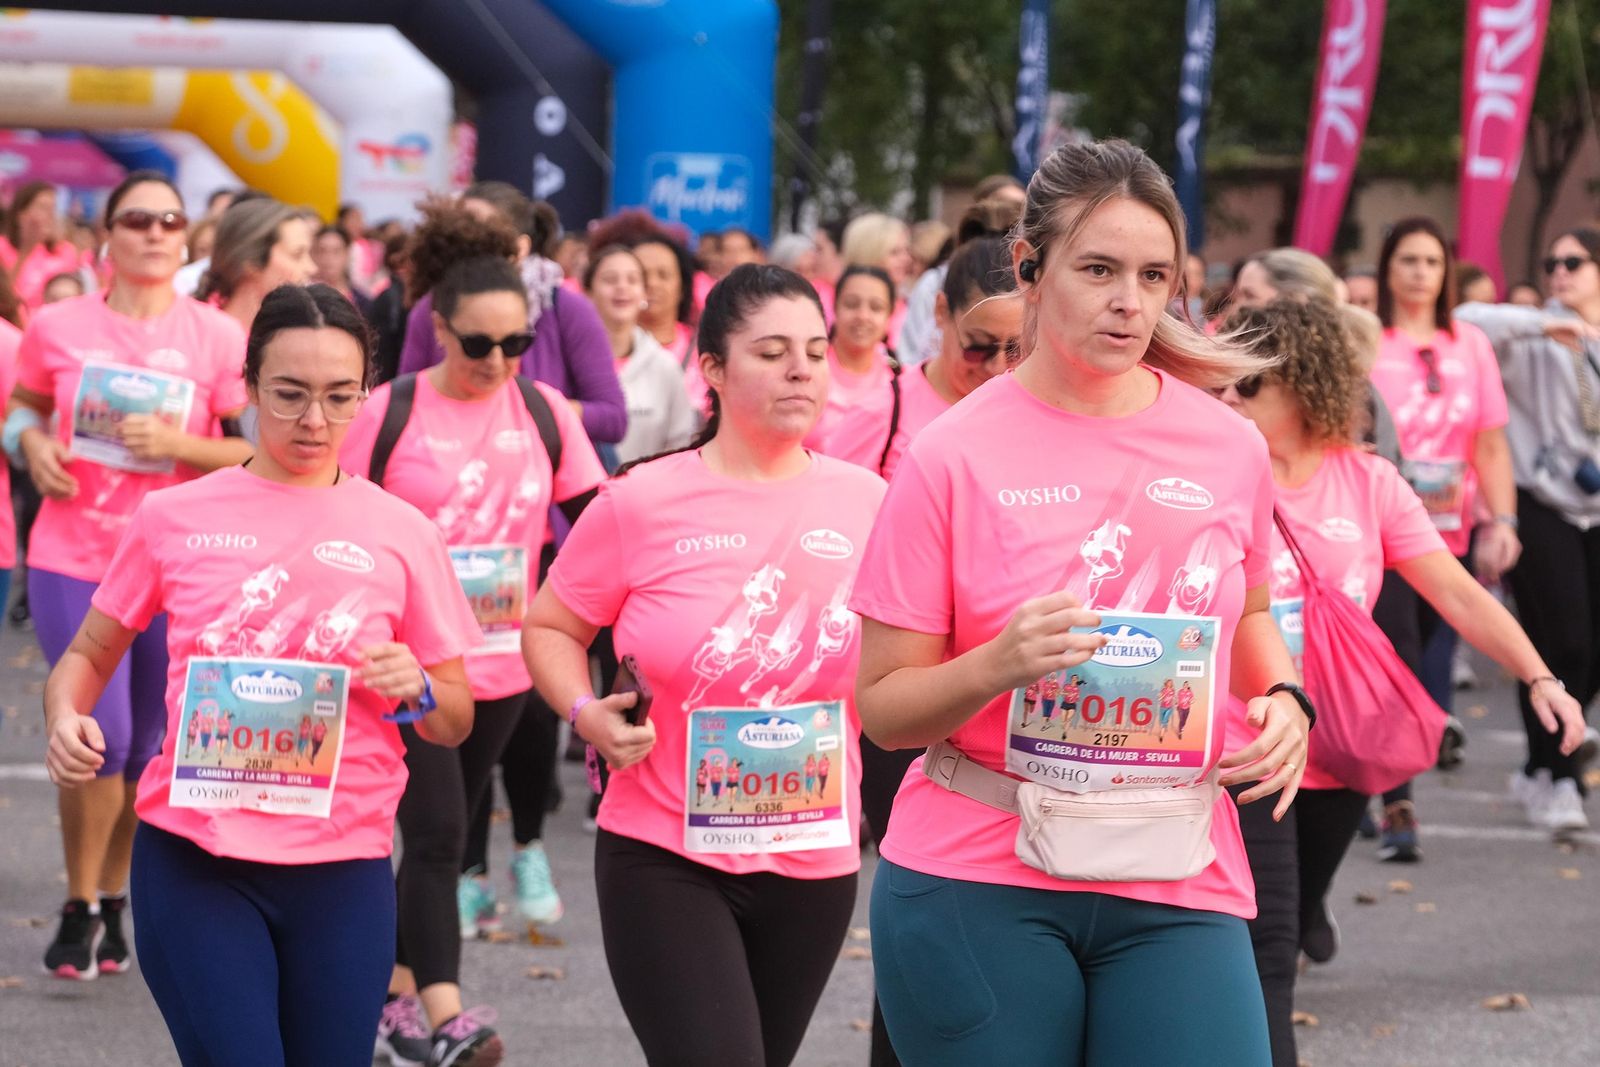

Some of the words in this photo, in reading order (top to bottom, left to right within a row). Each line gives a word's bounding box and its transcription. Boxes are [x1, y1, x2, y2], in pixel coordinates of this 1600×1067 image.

[998, 484, 1081, 506] OYSHO
[1152, 486, 1209, 505] ASTURIANA
[186, 533, 257, 549] OYSHO
[675, 533, 747, 555] OYSHO
[1095, 645, 1157, 658] STURIANA
[233, 681, 298, 697] ASTURIANA
[1081, 695, 1153, 727] 016
[232, 725, 295, 753] 016
[742, 730, 801, 742] ASTURIANA
[1093, 733, 1129, 746] 2197
[1035, 742, 1077, 756] CARRERA
[1080, 748, 1093, 759] DE
[1094, 749, 1107, 760] LA
[1108, 750, 1139, 762] MUJER
[1145, 752, 1180, 763] SEVILLA
[245, 758, 273, 769] 2838
[196, 768, 232, 779] CARRERA
[234, 770, 244, 780] DE
[245, 771, 255, 781] LA
[1026, 760, 1089, 784] OYSHO
[742, 771, 801, 796] 016
[1125, 774, 1181, 785] Santander
[189, 786, 239, 799] OYSHO
[270, 792, 312, 804] Santander
[755, 802, 783, 813] 6336
[709, 815, 744, 825] CARRERA
[745, 815, 755, 825] DE
[757, 815, 767, 824] LA
[768, 813, 792, 824] MUJER
[797, 810, 824, 822] SEVILLA
[703, 832, 755, 844] OYSHO
[784, 831, 830, 842] Santander
